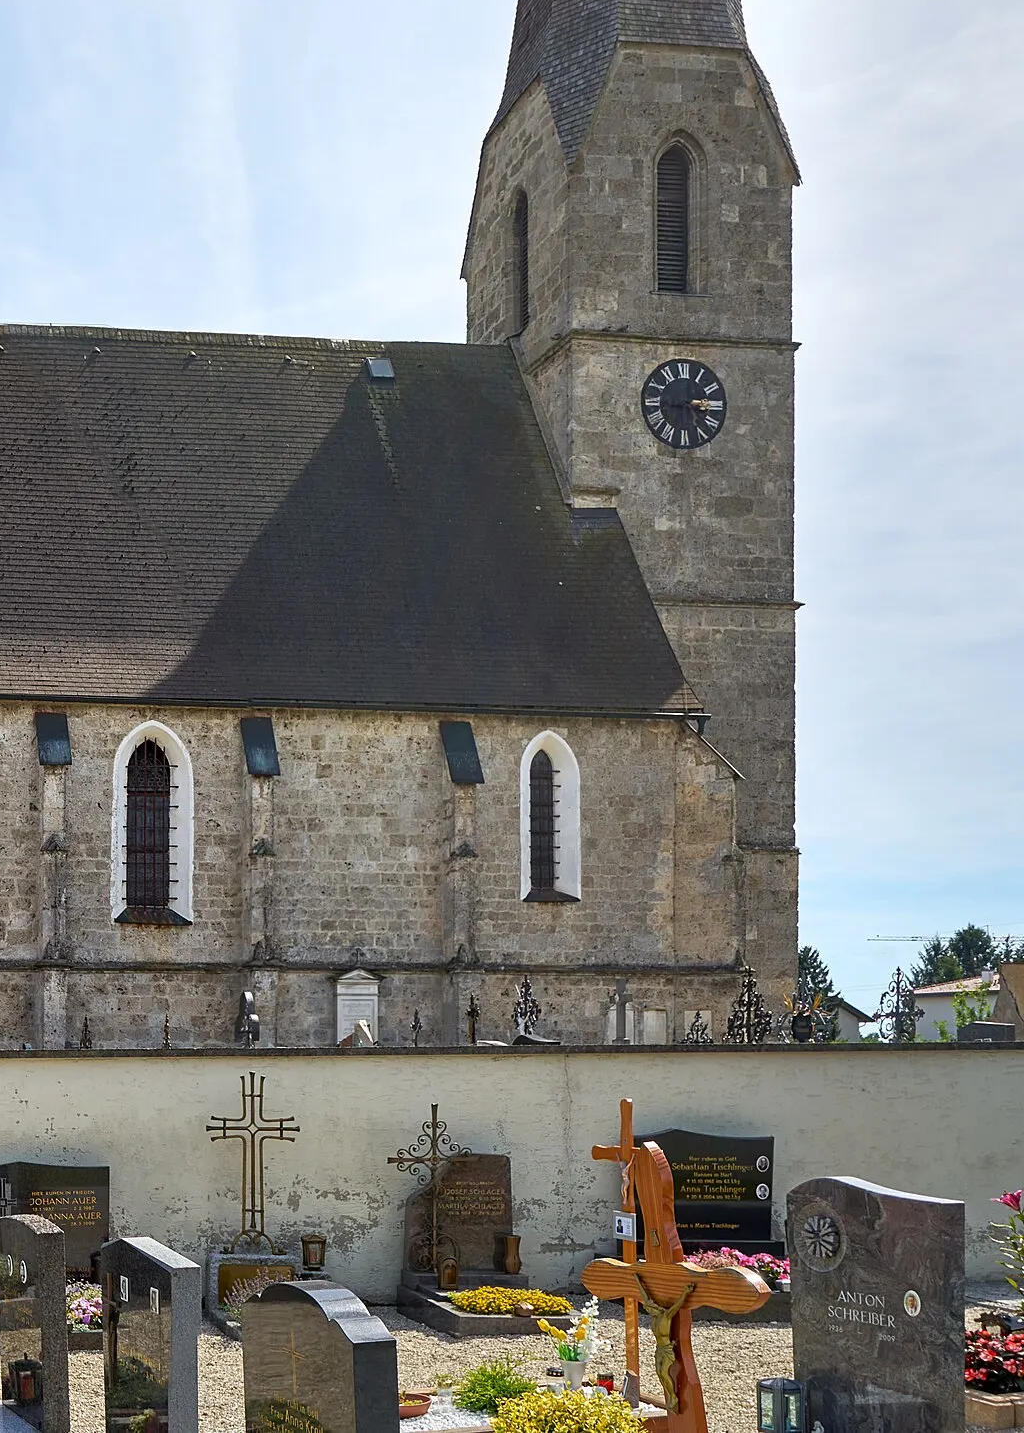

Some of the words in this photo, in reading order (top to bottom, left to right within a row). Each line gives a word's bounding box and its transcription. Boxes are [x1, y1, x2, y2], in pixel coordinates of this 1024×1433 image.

[671, 1163, 709, 1171] Sebastian
[712, 1163, 754, 1173] Tischlinger
[703, 1185, 746, 1195] Tischlinger
[29, 1197, 70, 1206] JOHANN
[71, 1196, 97, 1205] AUER
[76, 1212, 102, 1220] AUER
[837, 1290, 885, 1308] ANTON
[828, 1305, 896, 1328] SCHREIBER
[878, 1333, 895, 1342] 2009
[285, 1409, 304, 1431] Anna
